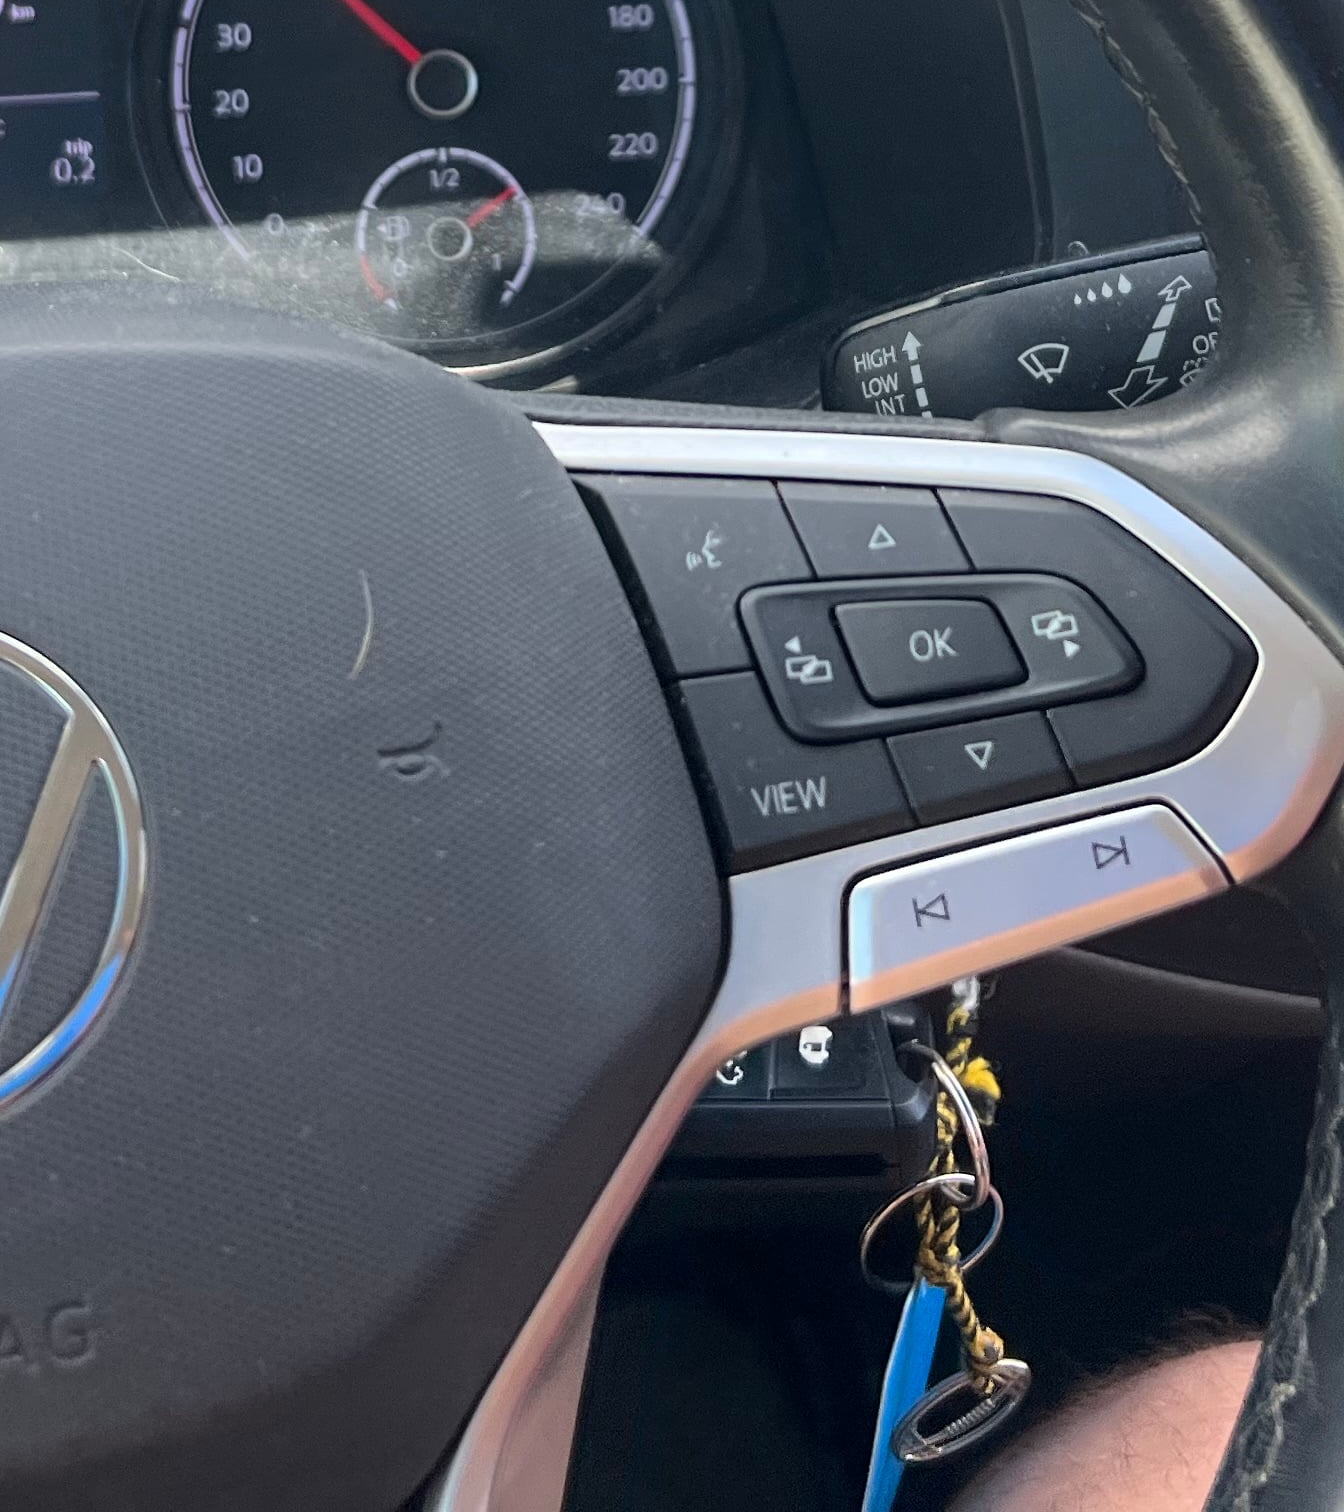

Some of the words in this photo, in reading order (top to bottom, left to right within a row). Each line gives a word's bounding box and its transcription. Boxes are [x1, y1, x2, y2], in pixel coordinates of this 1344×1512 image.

[608, 4, 654, 29] 180
[216, 22, 253, 48] 30
[616, 66, 668, 94] 200
[213, 88, 251, 114] 20
[609, 131, 657, 157] 220
[232, 155, 264, 181] 10
[429, 167, 460, 189] 1/2
[853, 345, 896, 374] HIGH
[861, 372, 898, 399] LOW
[875, 394, 905, 417] INT
[908, 627, 958, 663] OK
[751, 776, 827, 818] VIEW
